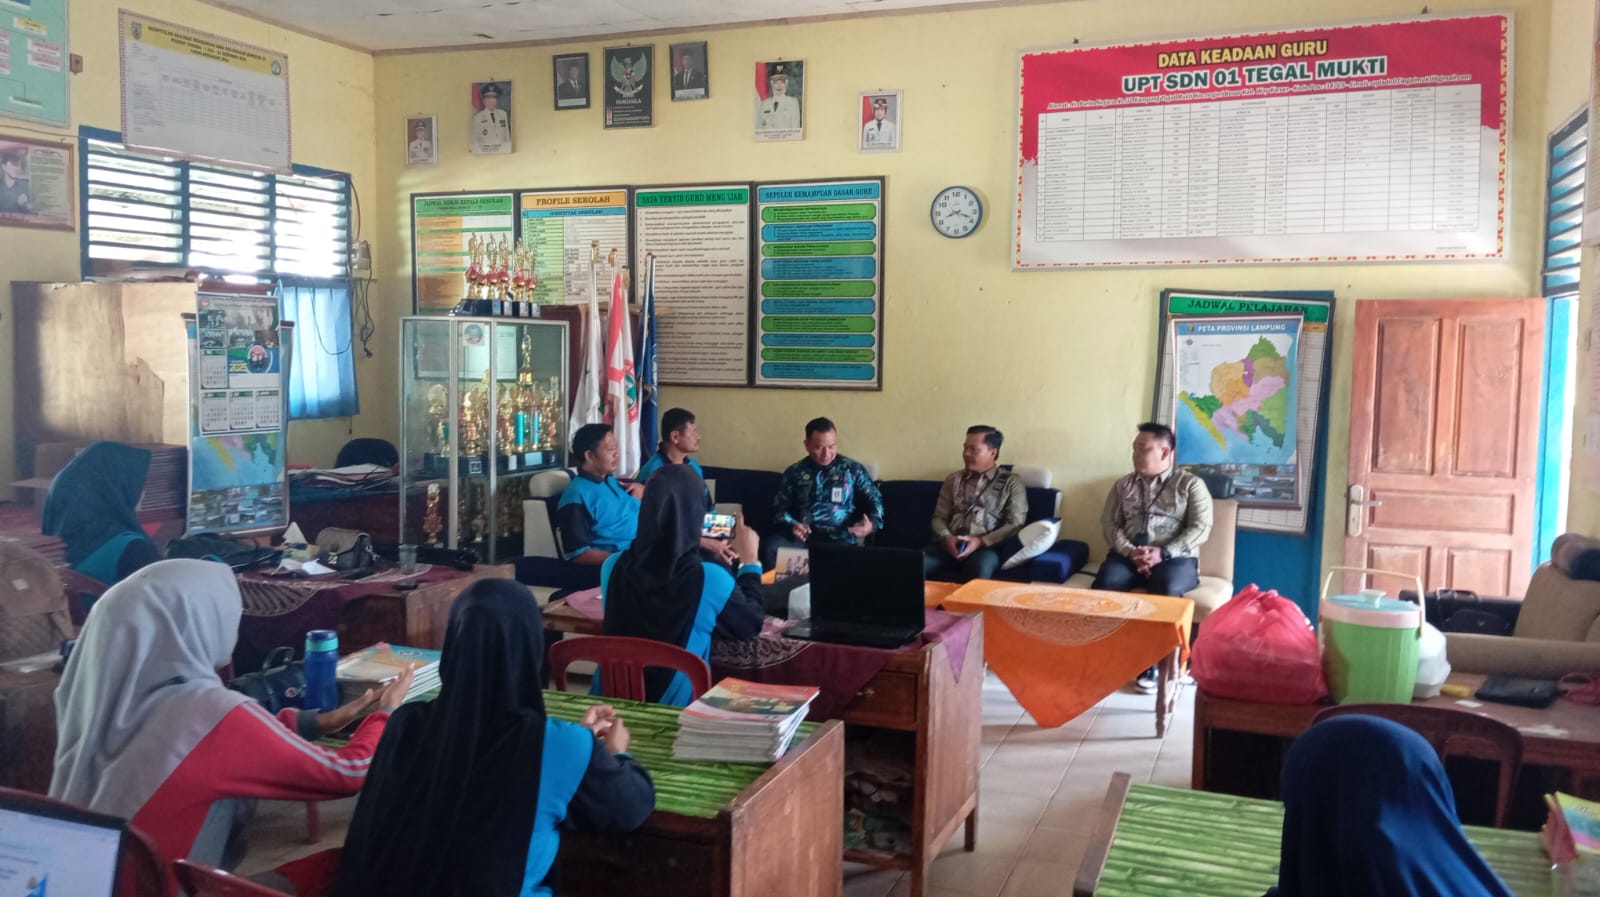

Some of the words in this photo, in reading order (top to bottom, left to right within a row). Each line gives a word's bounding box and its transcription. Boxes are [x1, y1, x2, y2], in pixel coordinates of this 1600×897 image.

[1158, 51, 1197, 68] DATA
[1200, 46, 1276, 64] KEADAAN
[1281, 40, 1328, 57] GURU
[1122, 75, 1161, 92] UPT
[1165, 71, 1208, 89] SDN
[1214, 68, 1239, 86] 01
[1245, 62, 1311, 83] TEGAL
[1317, 56, 1387, 78] MUKTI
[536, 197, 571, 206] PROFILE
[572, 195, 611, 204] SEKOLAH
[1187, 299, 1235, 311] JADWAL
[1197, 325, 1218, 333] PETA
[1219, 324, 1250, 332] PROVINSI
[1251, 323, 1286, 332] LAMPUNG
